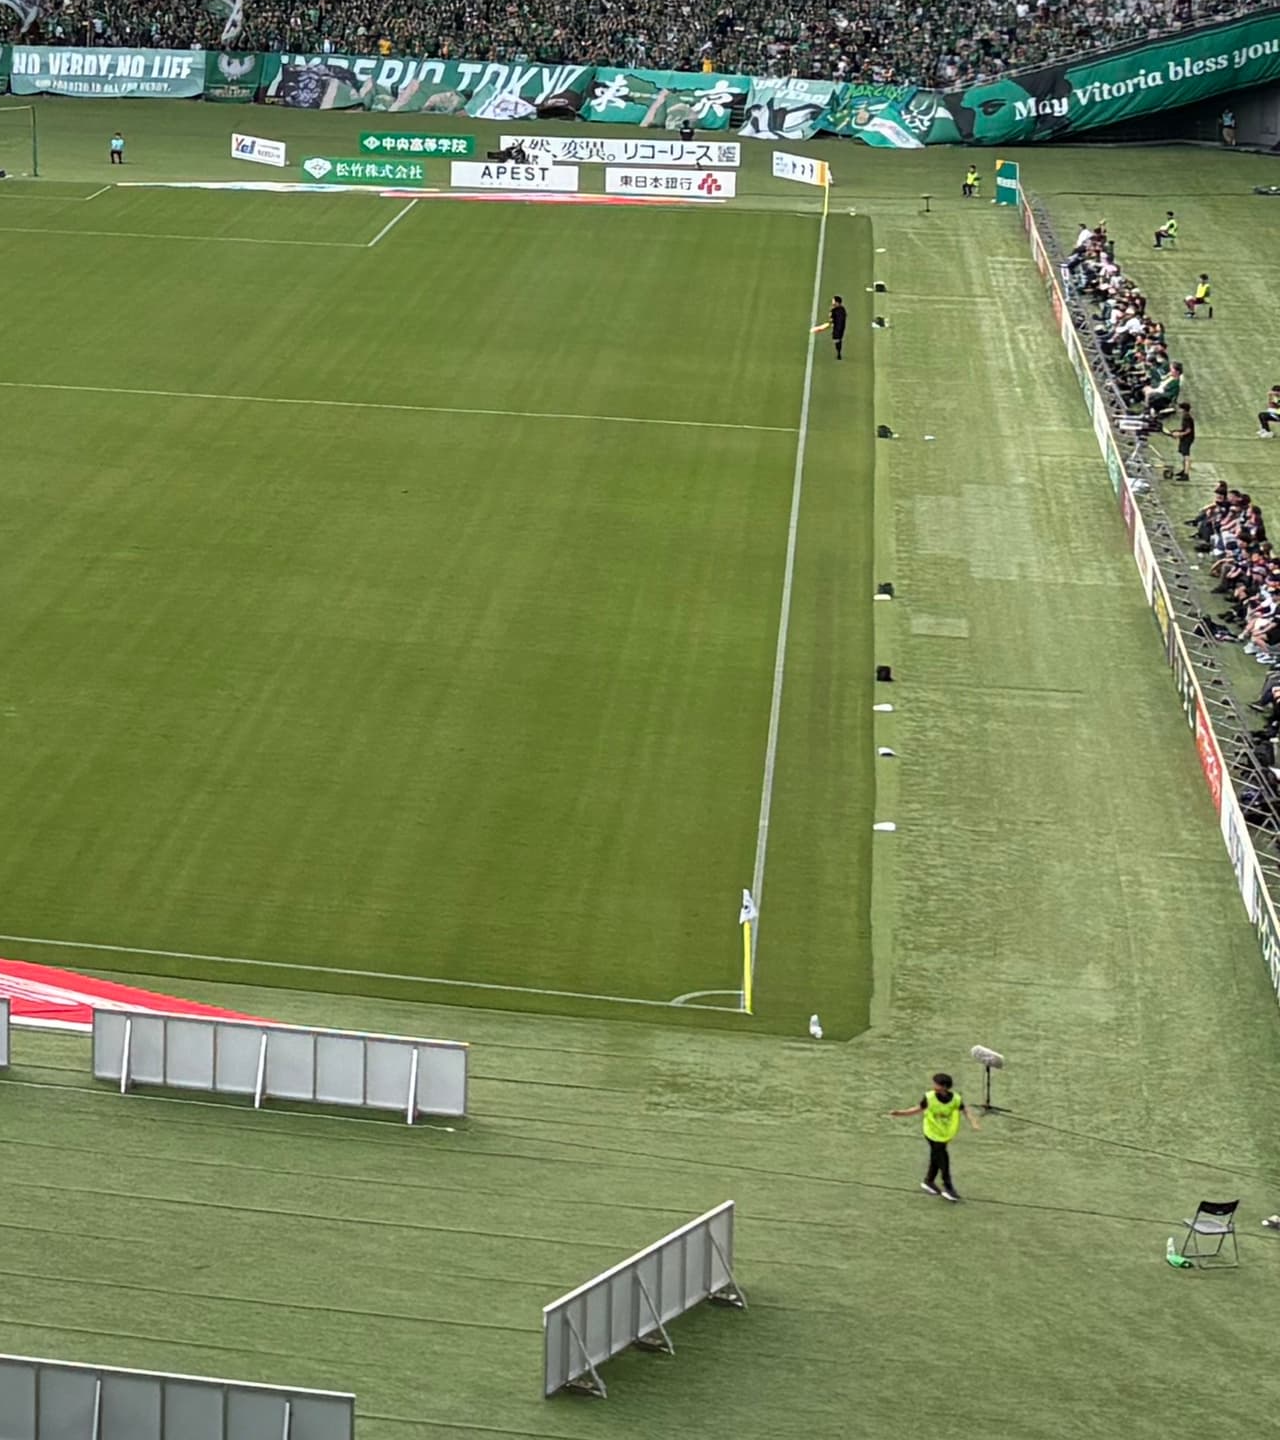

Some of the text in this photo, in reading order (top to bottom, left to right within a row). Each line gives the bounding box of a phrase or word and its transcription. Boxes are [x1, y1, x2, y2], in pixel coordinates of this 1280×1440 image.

[12, 53, 193, 79] NO LIFE
[1013, 38, 1280, 121] May Vitoria bless you
[382, 137, 468, 153] 中央高等学院
[624, 143, 713, 161] リコーリース
[336, 163, 423, 179] 松竹株式会社
[481, 165, 549, 182] APEST
[620, 174, 692, 191] 東日本銀行
